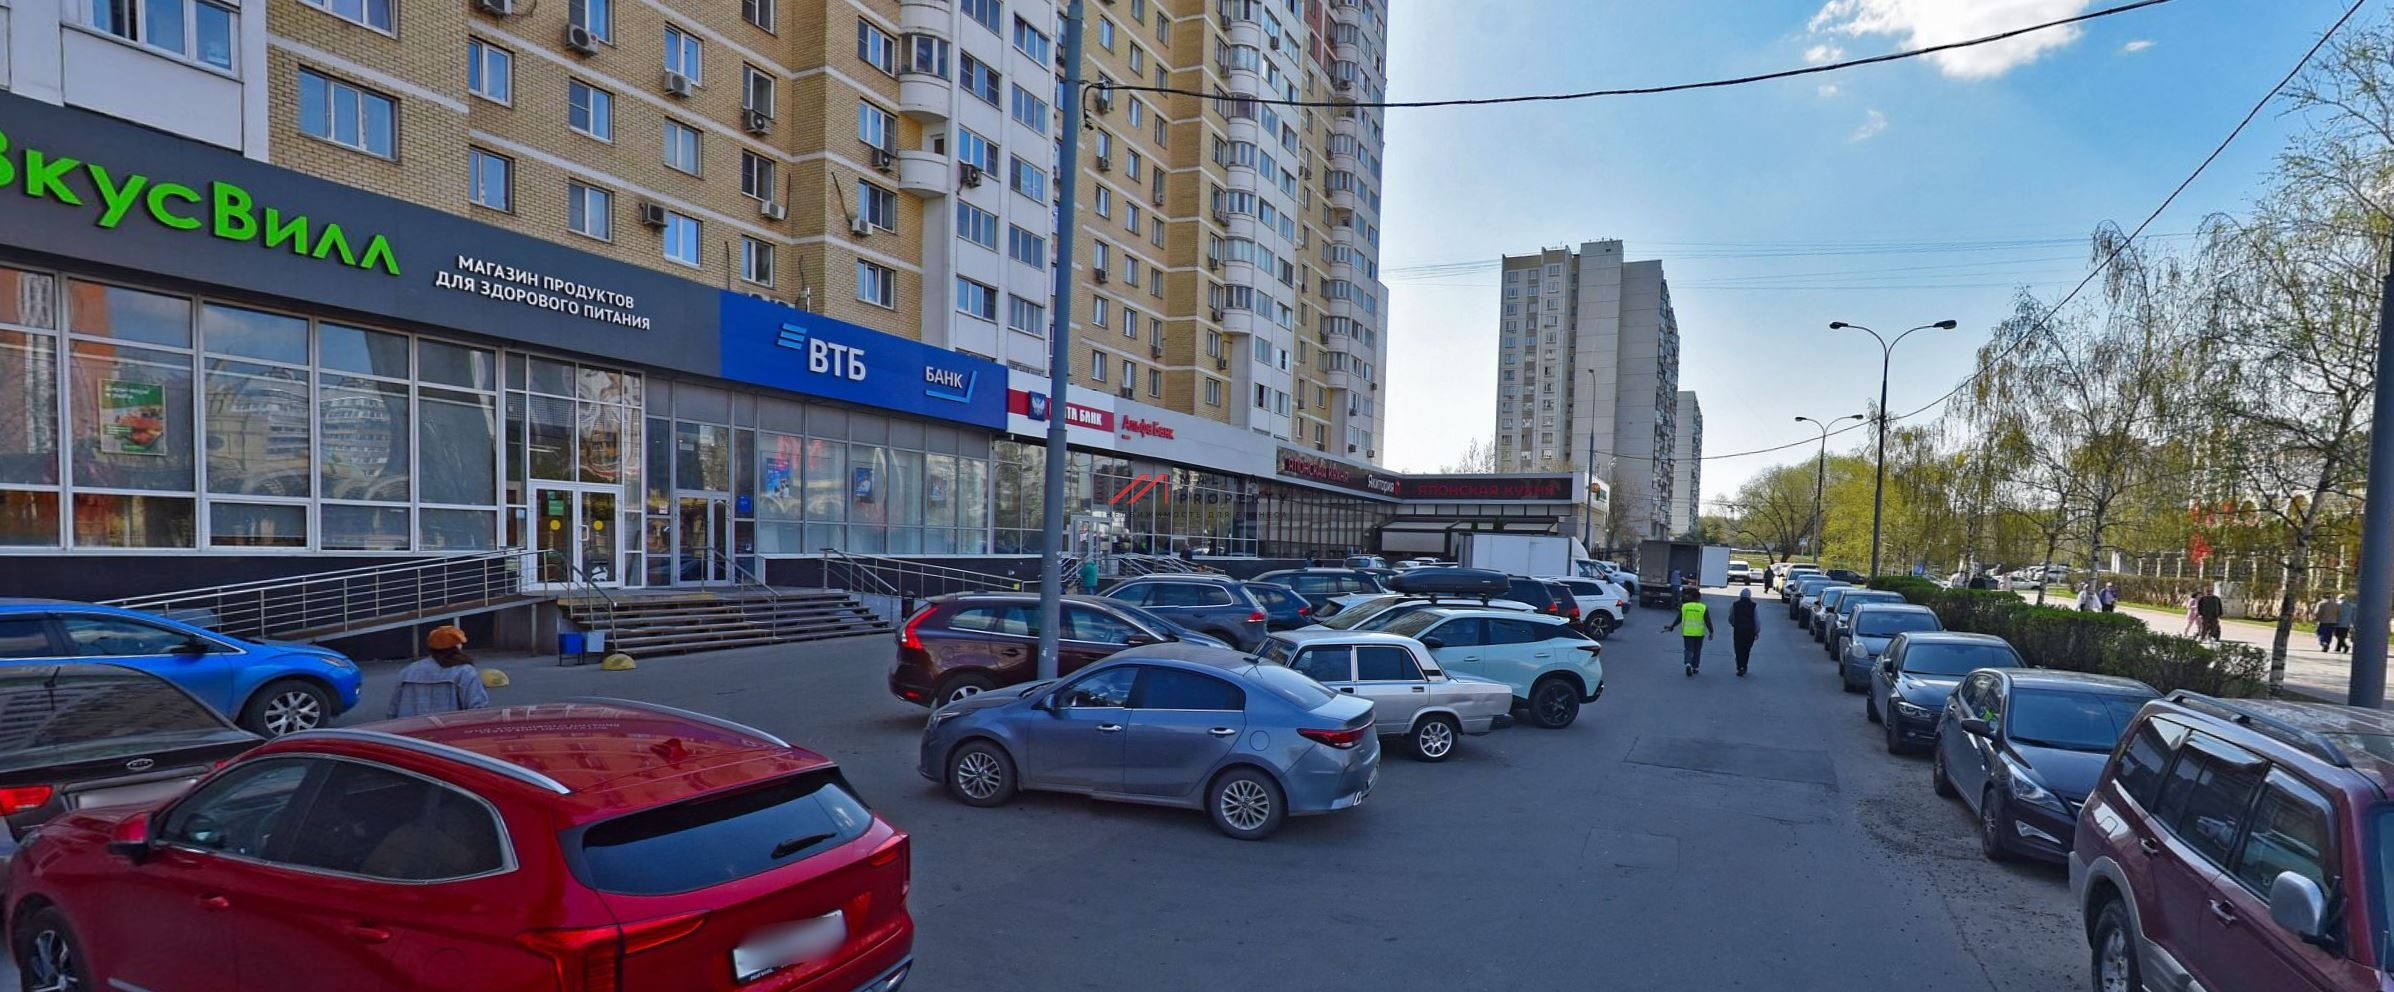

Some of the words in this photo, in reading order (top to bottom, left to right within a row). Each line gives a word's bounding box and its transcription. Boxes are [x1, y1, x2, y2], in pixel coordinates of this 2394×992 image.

[457, 255, 538, 287] МАГАЗИН
[543, 276, 634, 309] ПРОДУКТОВ
[436, 271, 475, 293] ДЛЯ
[480, 280, 579, 315] ЗДОРОВОГО
[583, 305, 650, 330] ПИТАНИЯ
[808, 338, 866, 381] ВТБ
[925, 366, 964, 389] БАНК
[1079, 409, 1103, 426] БАНК
[1417, 484, 1499, 497] ЯПОНСКАЯ
[1504, 484, 1555, 497] КУХНЯ
